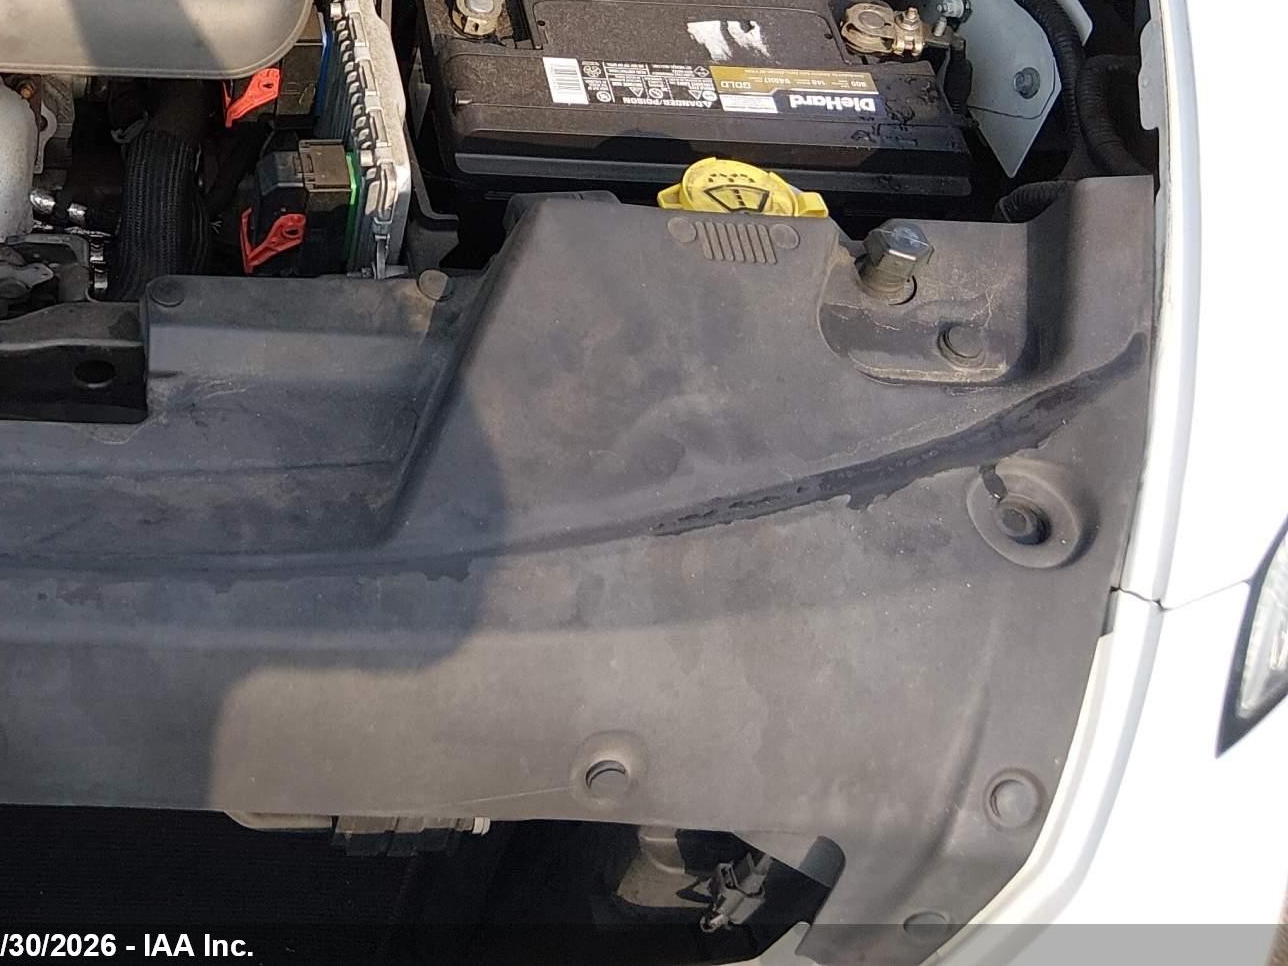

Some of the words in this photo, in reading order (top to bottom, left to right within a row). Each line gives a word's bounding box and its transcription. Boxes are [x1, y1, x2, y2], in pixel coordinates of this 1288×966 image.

[720, 80, 752, 90] GOLD
[622, 96, 703, 108] DANGER/POISON
[789, 94, 877, 113] DieHard
